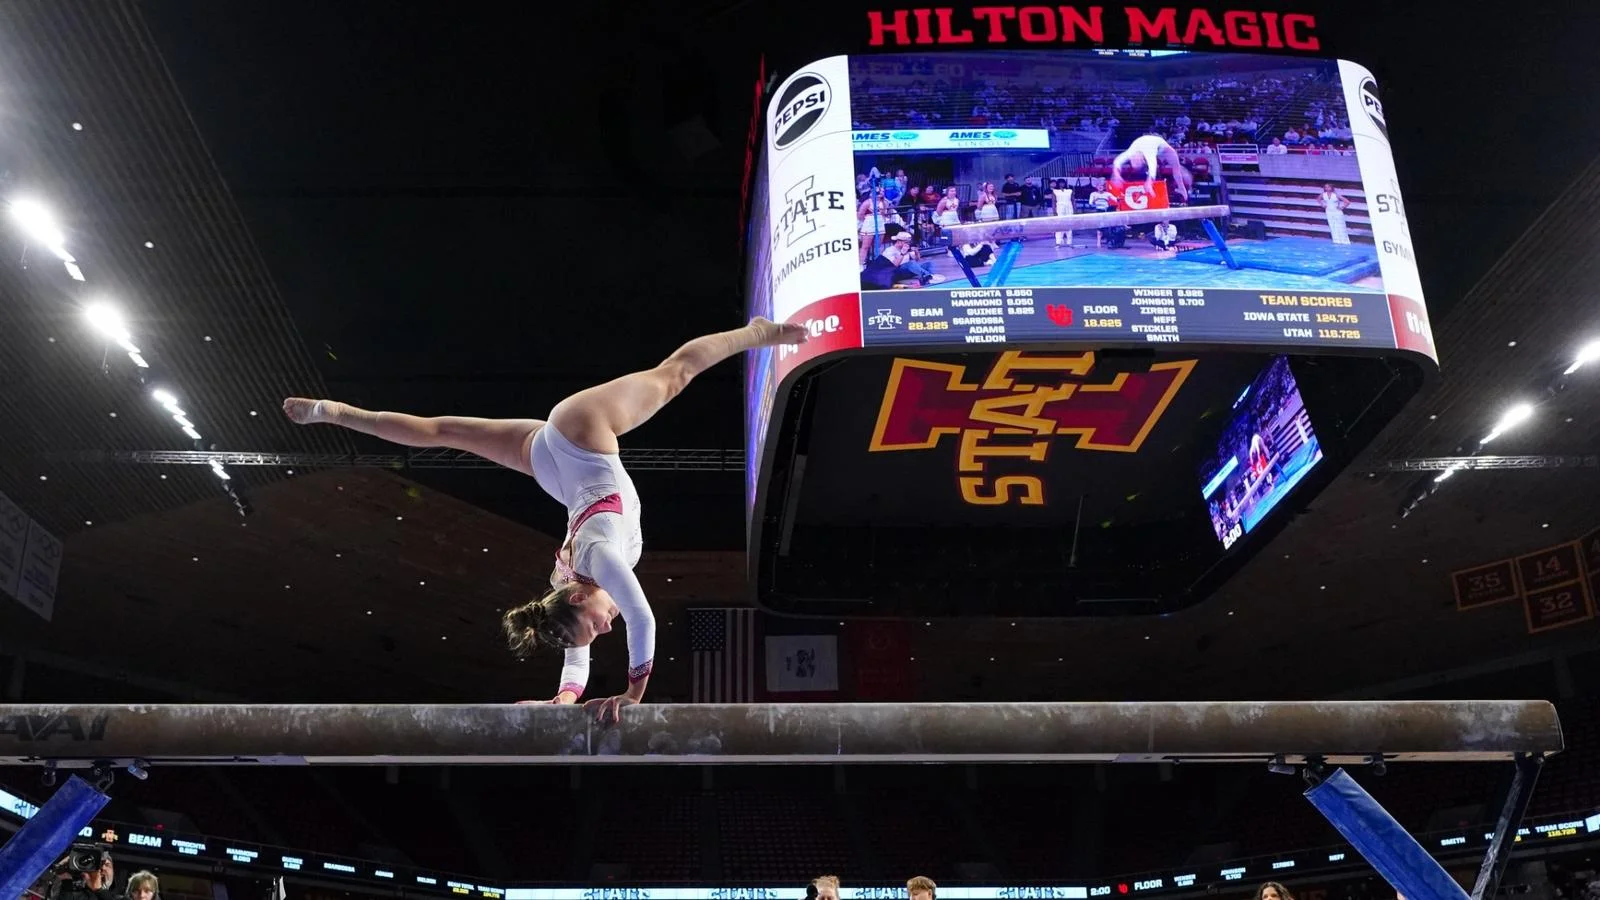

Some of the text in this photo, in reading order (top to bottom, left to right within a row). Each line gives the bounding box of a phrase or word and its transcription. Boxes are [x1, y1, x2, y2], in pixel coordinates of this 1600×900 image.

[867, 6, 1320, 50] HILTON MAGIC
[774, 90, 825, 135] PEPSI
[949, 131, 991, 139] AMES
[1125, 185, 1149, 210] G
[773, 191, 845, 251] STATE
[951, 298, 1003, 307] HAMMOND
[1131, 298, 1175, 306] JOHNSON
[1260, 295, 1353, 308] TEAM SCORES
[910, 307, 944, 317] BEAM
[1083, 305, 1118, 314] FLOOR
[868, 314, 903, 326] STATE
[1153, 316, 1177, 324] NEFF
[1243, 312, 1275, 322] IOWA
[1277, 313, 1310, 323] STATE
[969, 326, 1006, 334] ADAMS
[1131, 325, 1178, 333] STICKLER
[1284, 328, 1313, 338] UTAH
[964, 335, 1007, 343] WELDON
[1146, 334, 1180, 342] SMITH
[1222, 523, 1243, 550] 2:00
[1535, 824, 1557, 833] TEAM
[128, 833, 162, 847] BEAM
[1134, 879, 1163, 891] FLOOR
[1090, 886, 1111, 896] 2:00
